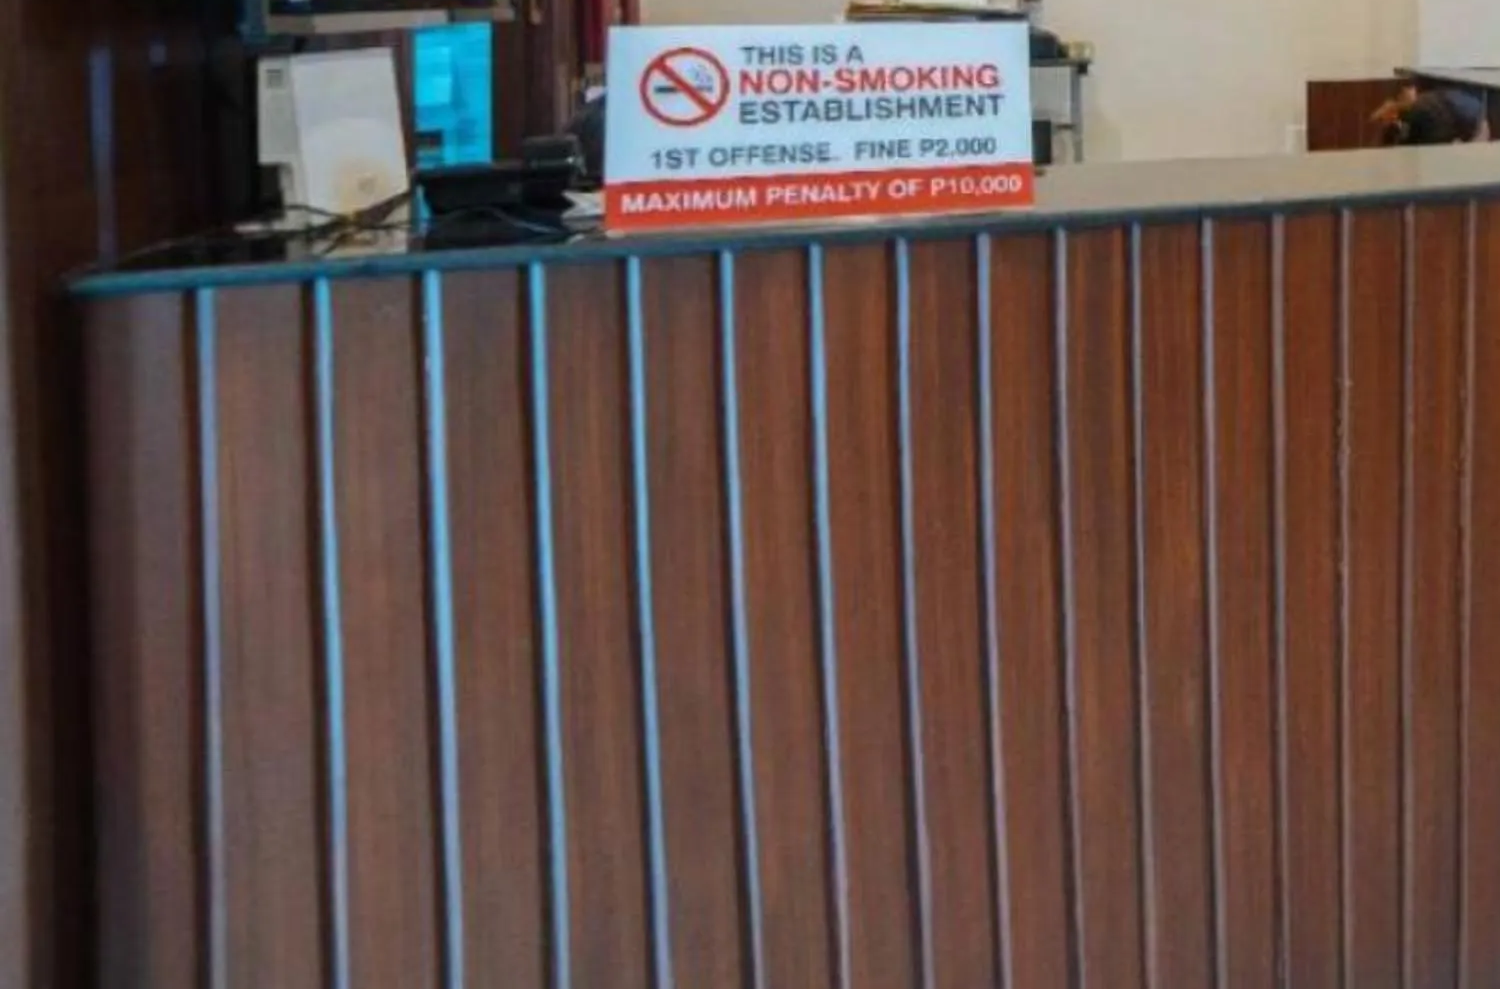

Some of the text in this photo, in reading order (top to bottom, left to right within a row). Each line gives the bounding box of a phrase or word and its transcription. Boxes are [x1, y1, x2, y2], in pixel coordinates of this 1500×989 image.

[740, 44, 865, 66] THIS IS A
[739, 64, 1000, 95] NON-SMOKING
[739, 94, 1005, 125] ESTABLISHMENT
[650, 148, 698, 170] 1ST
[855, 138, 912, 161] FINE
[620, 174, 1023, 214] MAXIMUM PENALTY OF P10,000
